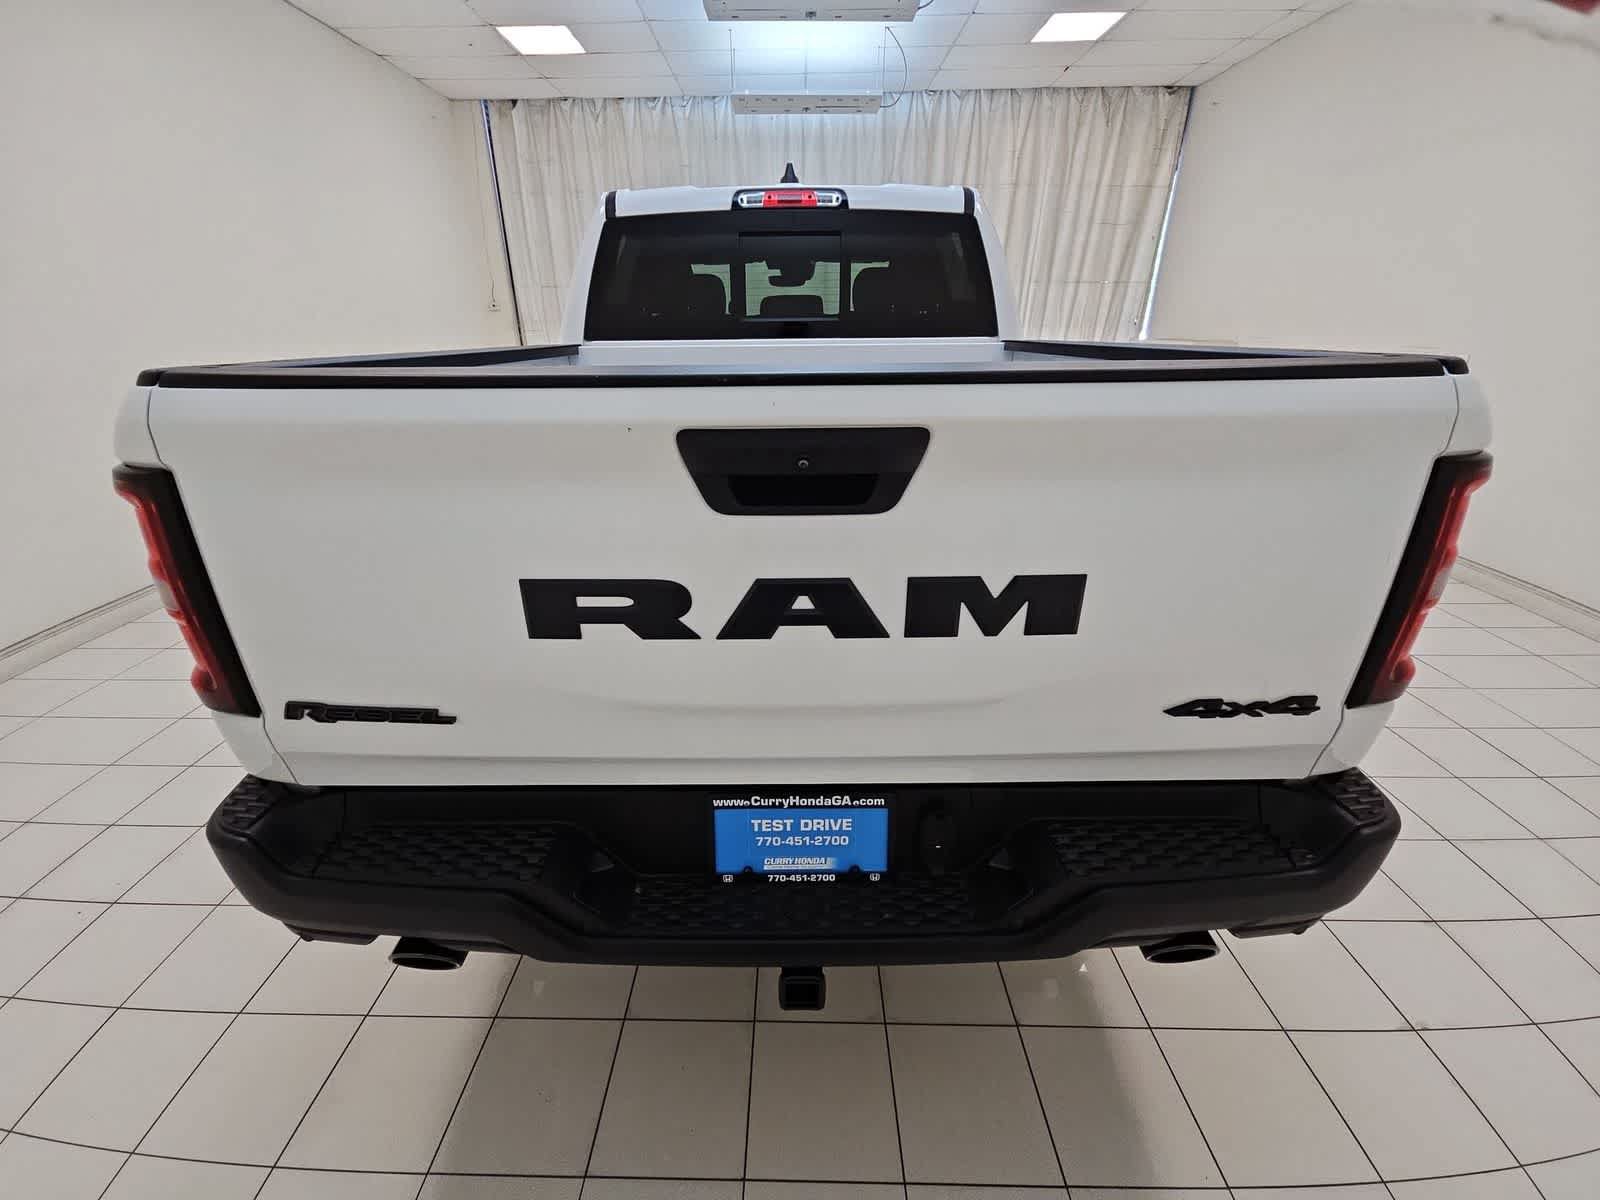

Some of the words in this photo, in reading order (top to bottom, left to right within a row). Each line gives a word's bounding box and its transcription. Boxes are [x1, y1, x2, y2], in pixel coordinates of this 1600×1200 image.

[519, 574, 1087, 640] RAM
[284, 701, 457, 724] REBEL
[1162, 695, 1320, 718] 4x4
[751, 819, 794, 832] TEST
[800, 818, 852, 832] DRIVE
[755, 835, 849, 846] 770-451-2700
[764, 857, 794, 865] CURRY
[795, 857, 826, 865] HONDA
[767, 874, 836, 882] 770-451-2700
